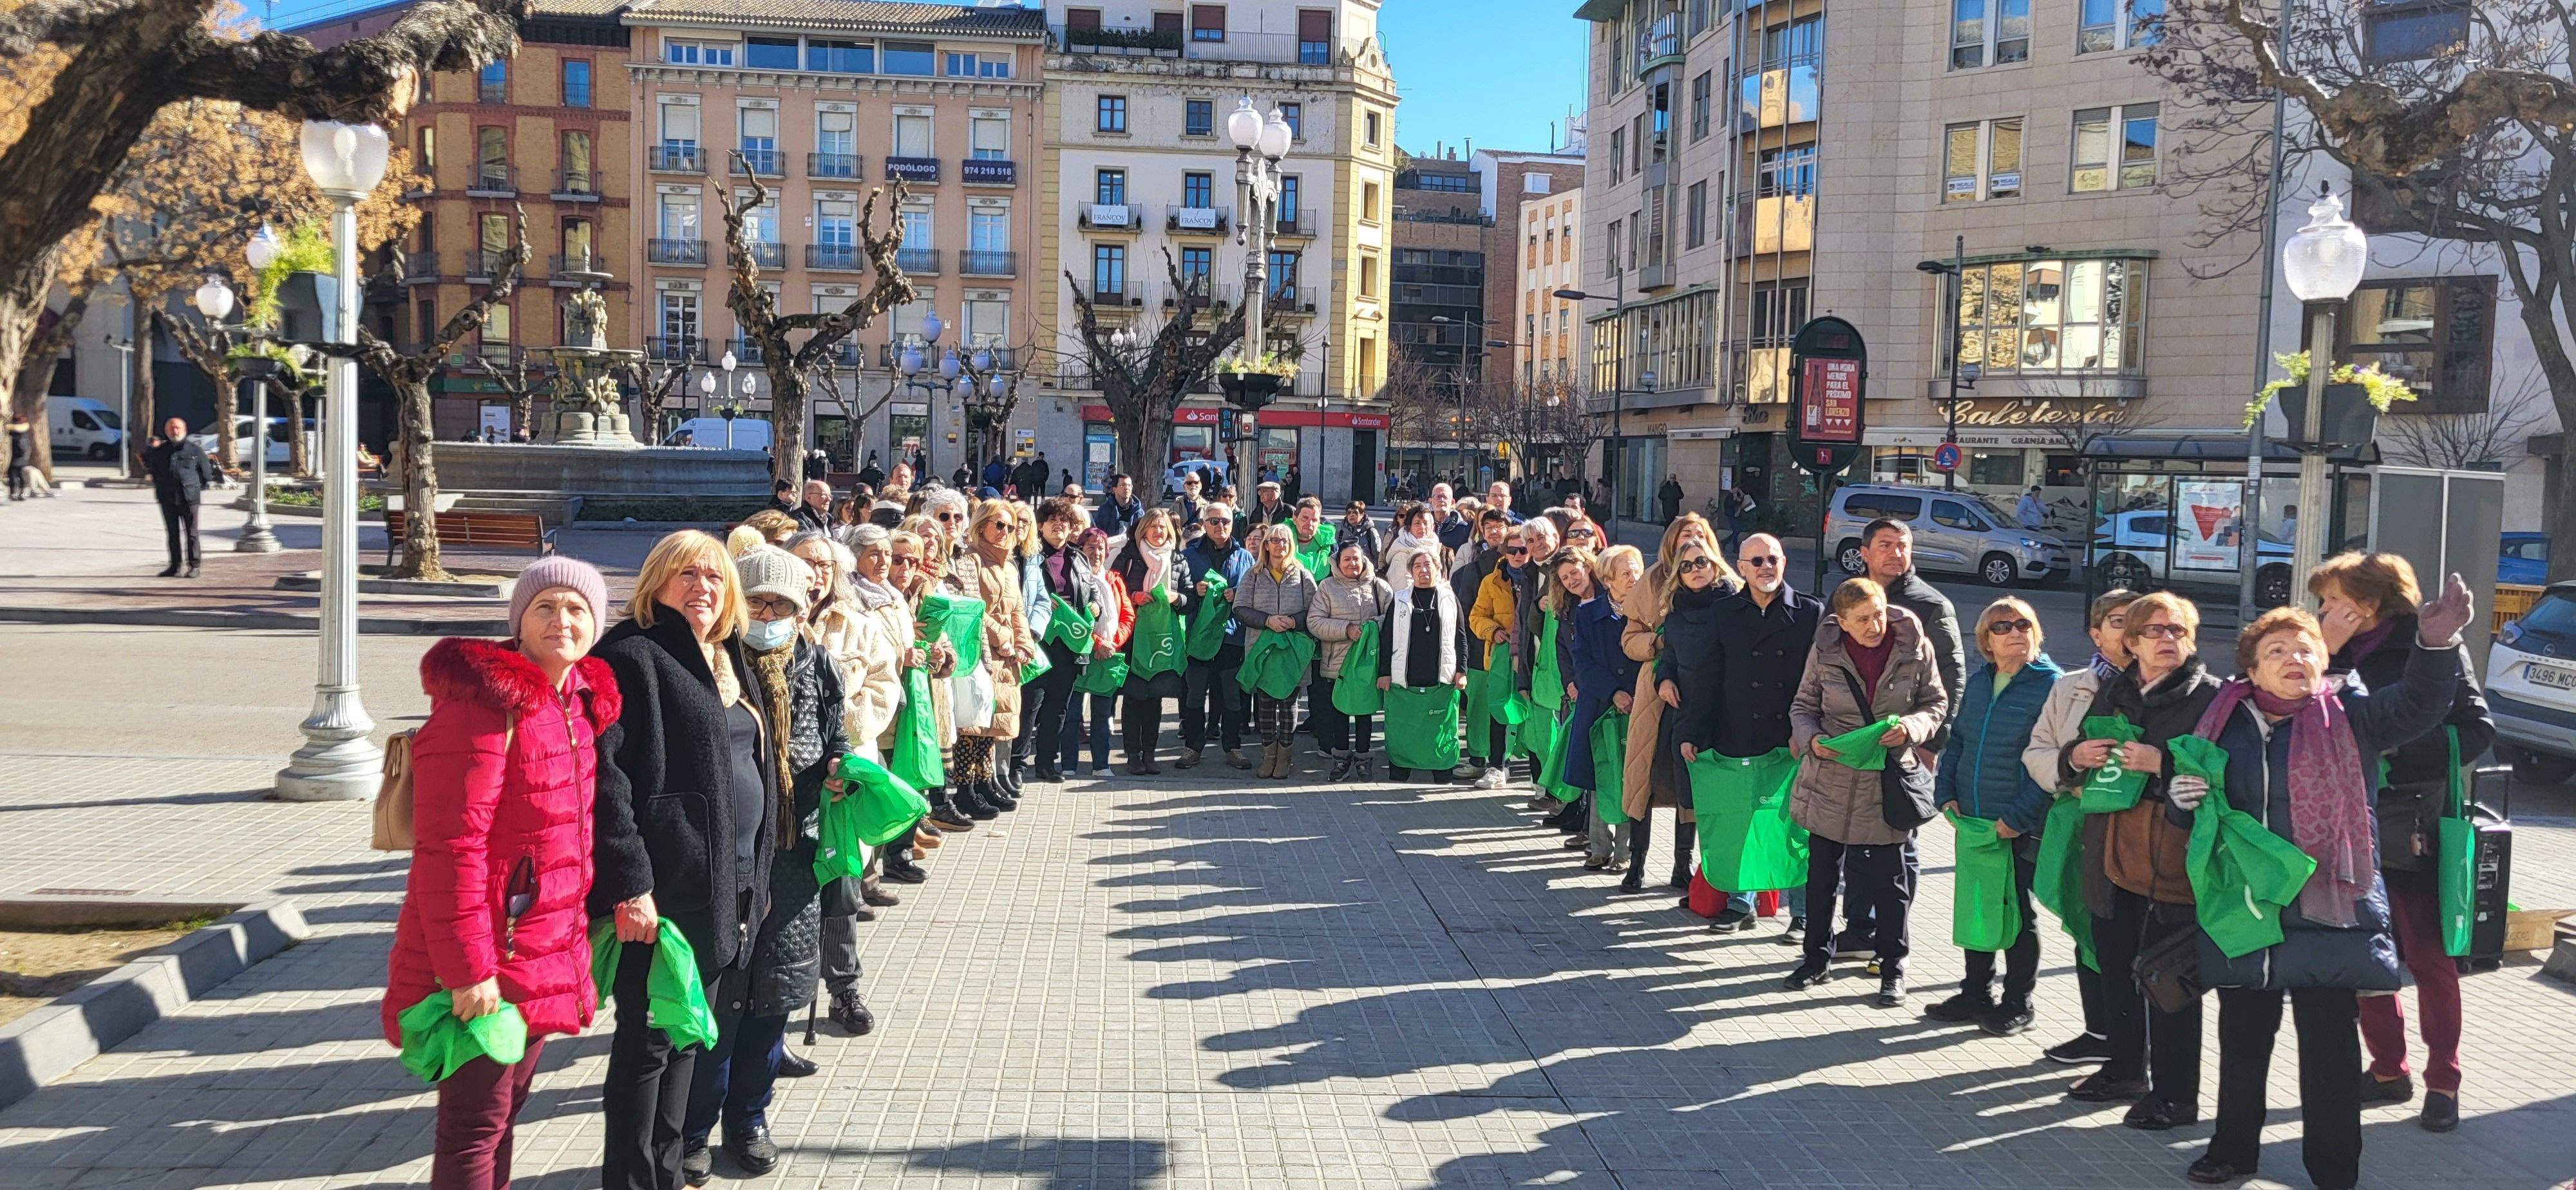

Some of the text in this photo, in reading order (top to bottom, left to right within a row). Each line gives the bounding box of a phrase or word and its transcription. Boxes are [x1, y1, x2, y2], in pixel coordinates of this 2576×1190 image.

[888, 162, 936, 173] PODÓLOGO
[964, 166, 1012, 176] 974 218 518
[1842, 381, 1850, 390] EL
[1938, 400, 2126, 425] Cafetería
[1358, 417, 1381, 426] Santander
[2529, 667, 2555, 683] 3496
